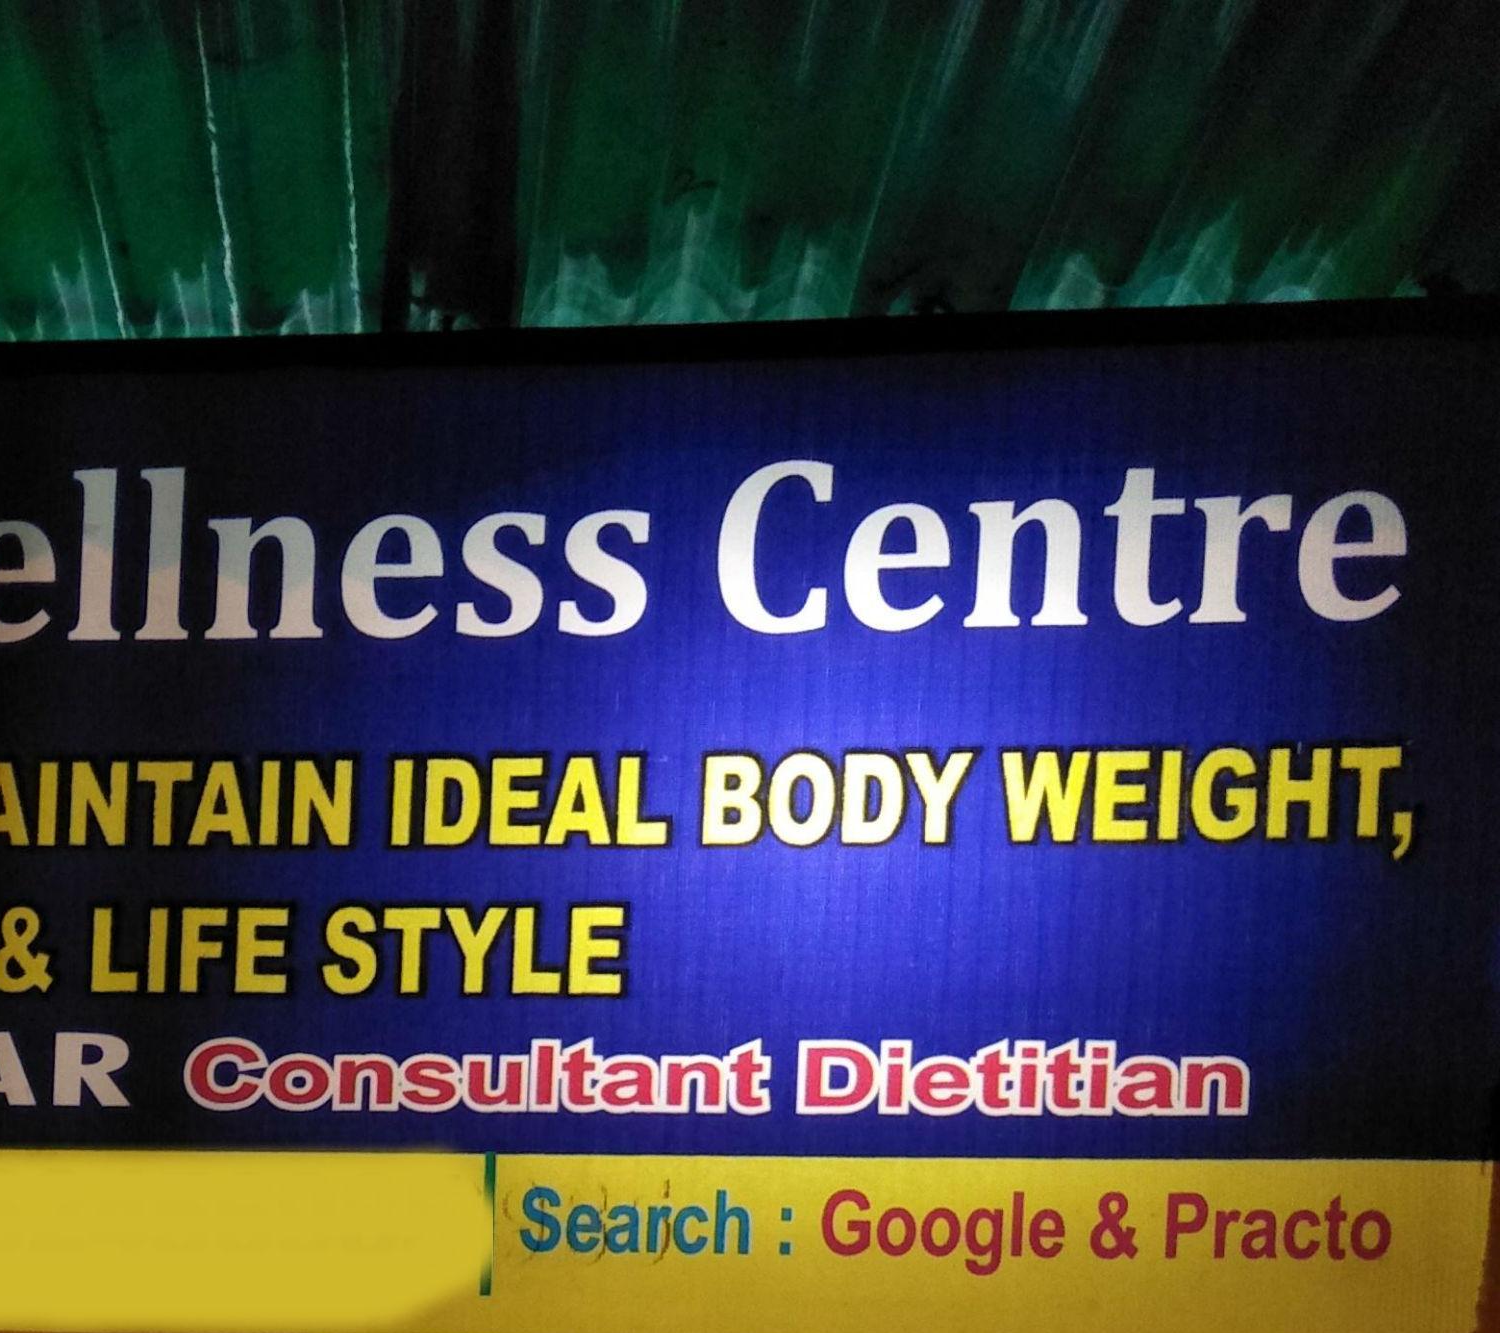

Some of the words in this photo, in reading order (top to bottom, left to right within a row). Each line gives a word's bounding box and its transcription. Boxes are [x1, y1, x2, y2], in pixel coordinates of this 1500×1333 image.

[716, 458, 1407, 635] Centre
[388, 754, 670, 849] IDEAL
[700, 750, 976, 848] BODY
[1004, 745, 1417, 862] WEIGHT,
[90, 906, 291, 994] LIFE
[320, 905, 628, 995] STYLE
[184, 1036, 773, 1114] Consultant
[795, 1036, 1251, 1118] Dietitian
[518, 1186, 751, 1256] Search
[820, 1188, 1067, 1277] Google
[1088, 1191, 1139, 1261] &
[1163, 1193, 1394, 1262] Practo
